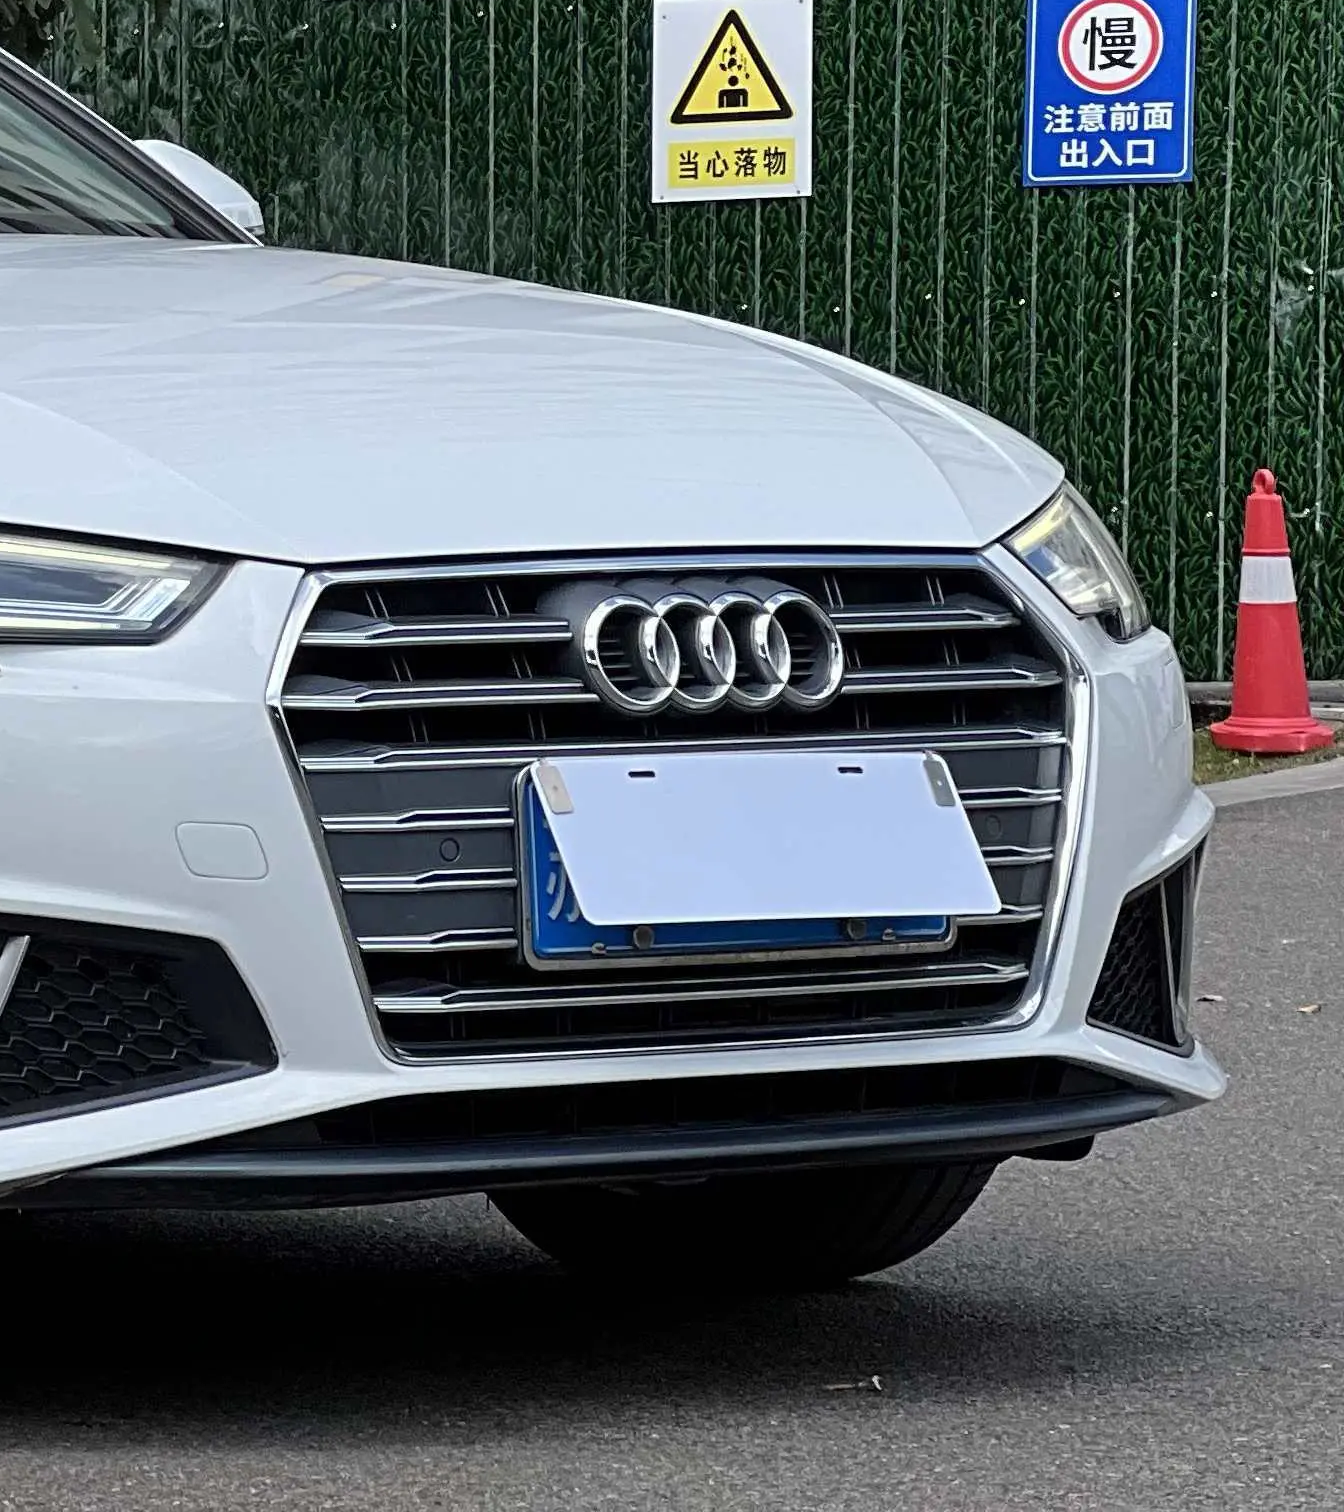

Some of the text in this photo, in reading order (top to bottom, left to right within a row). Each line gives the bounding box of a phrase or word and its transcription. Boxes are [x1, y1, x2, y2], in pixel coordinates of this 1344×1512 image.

[1082, 16, 1137, 71] 慢
[1043, 101, 1174, 134] 注意前面
[678, 147, 787, 180] 当心落物
[1058, 138, 1156, 169] 出入口
